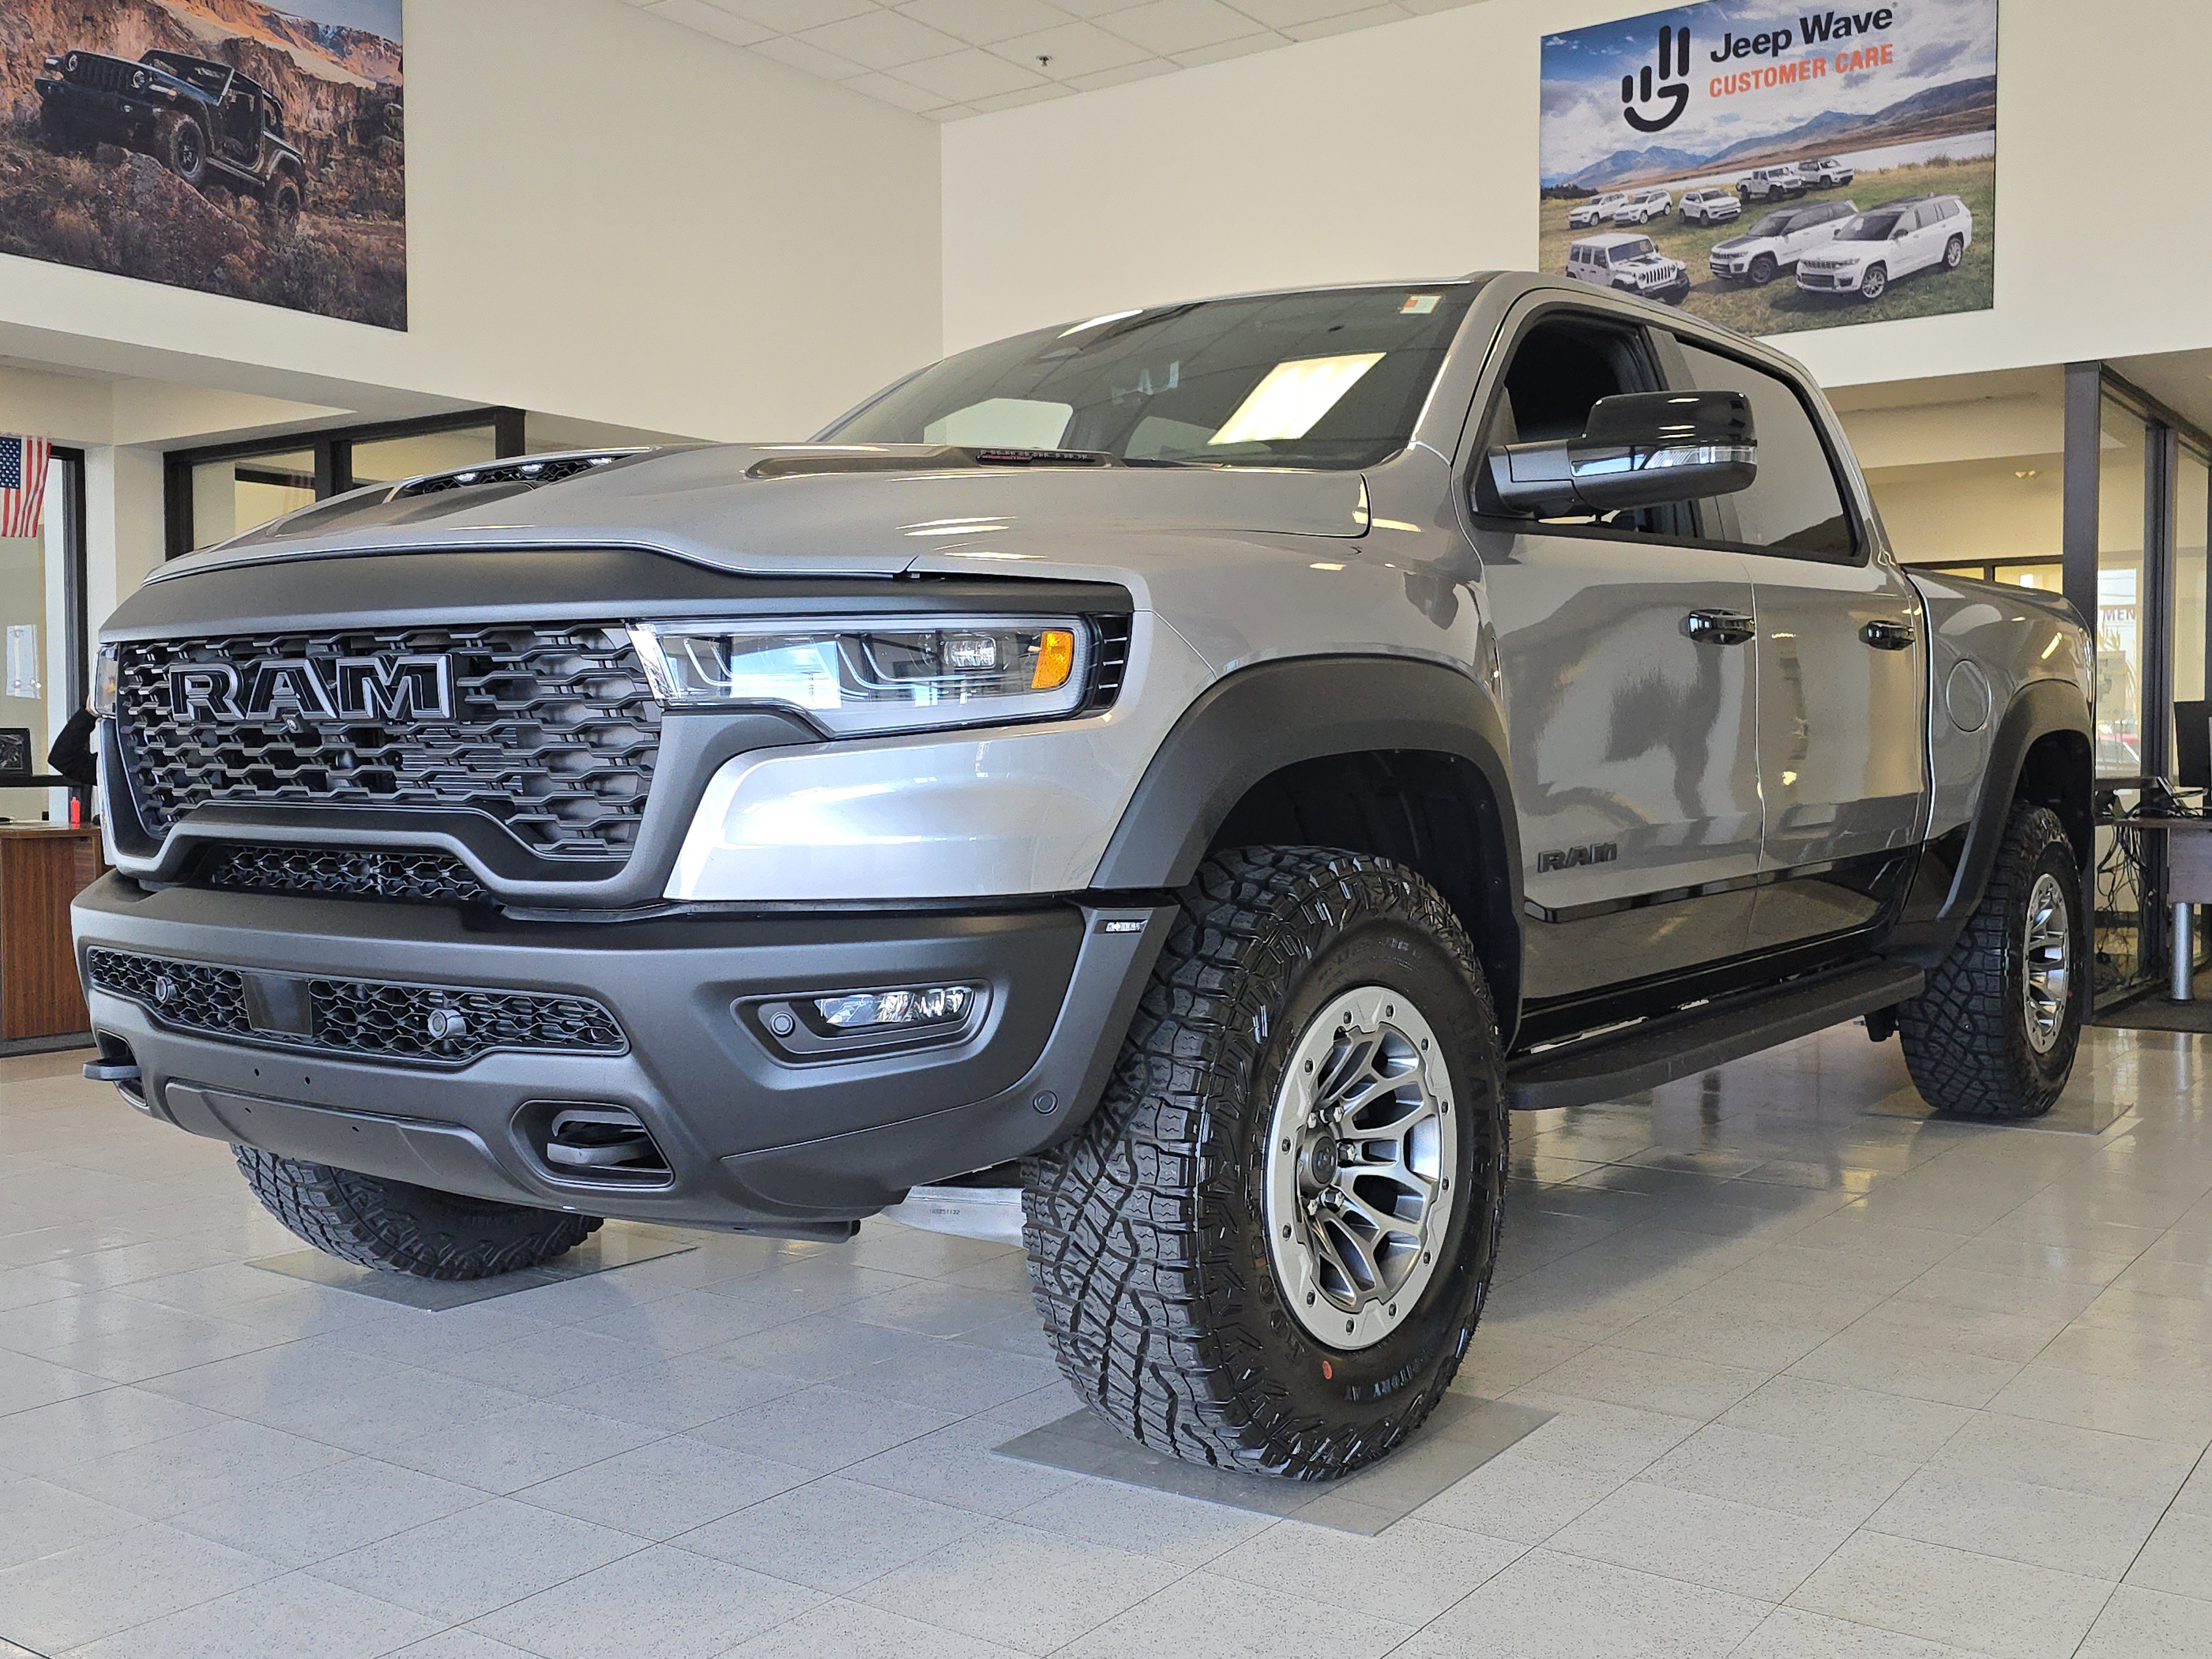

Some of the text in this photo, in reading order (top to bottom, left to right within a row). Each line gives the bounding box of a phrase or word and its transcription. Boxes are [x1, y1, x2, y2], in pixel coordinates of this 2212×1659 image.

[1710, 8, 1893, 62] Jeep Wave
[1709, 44, 1893, 98] CUSTOMER CARE
[170, 654, 453, 719] RAM
[1537, 841, 1618, 872] RAM
